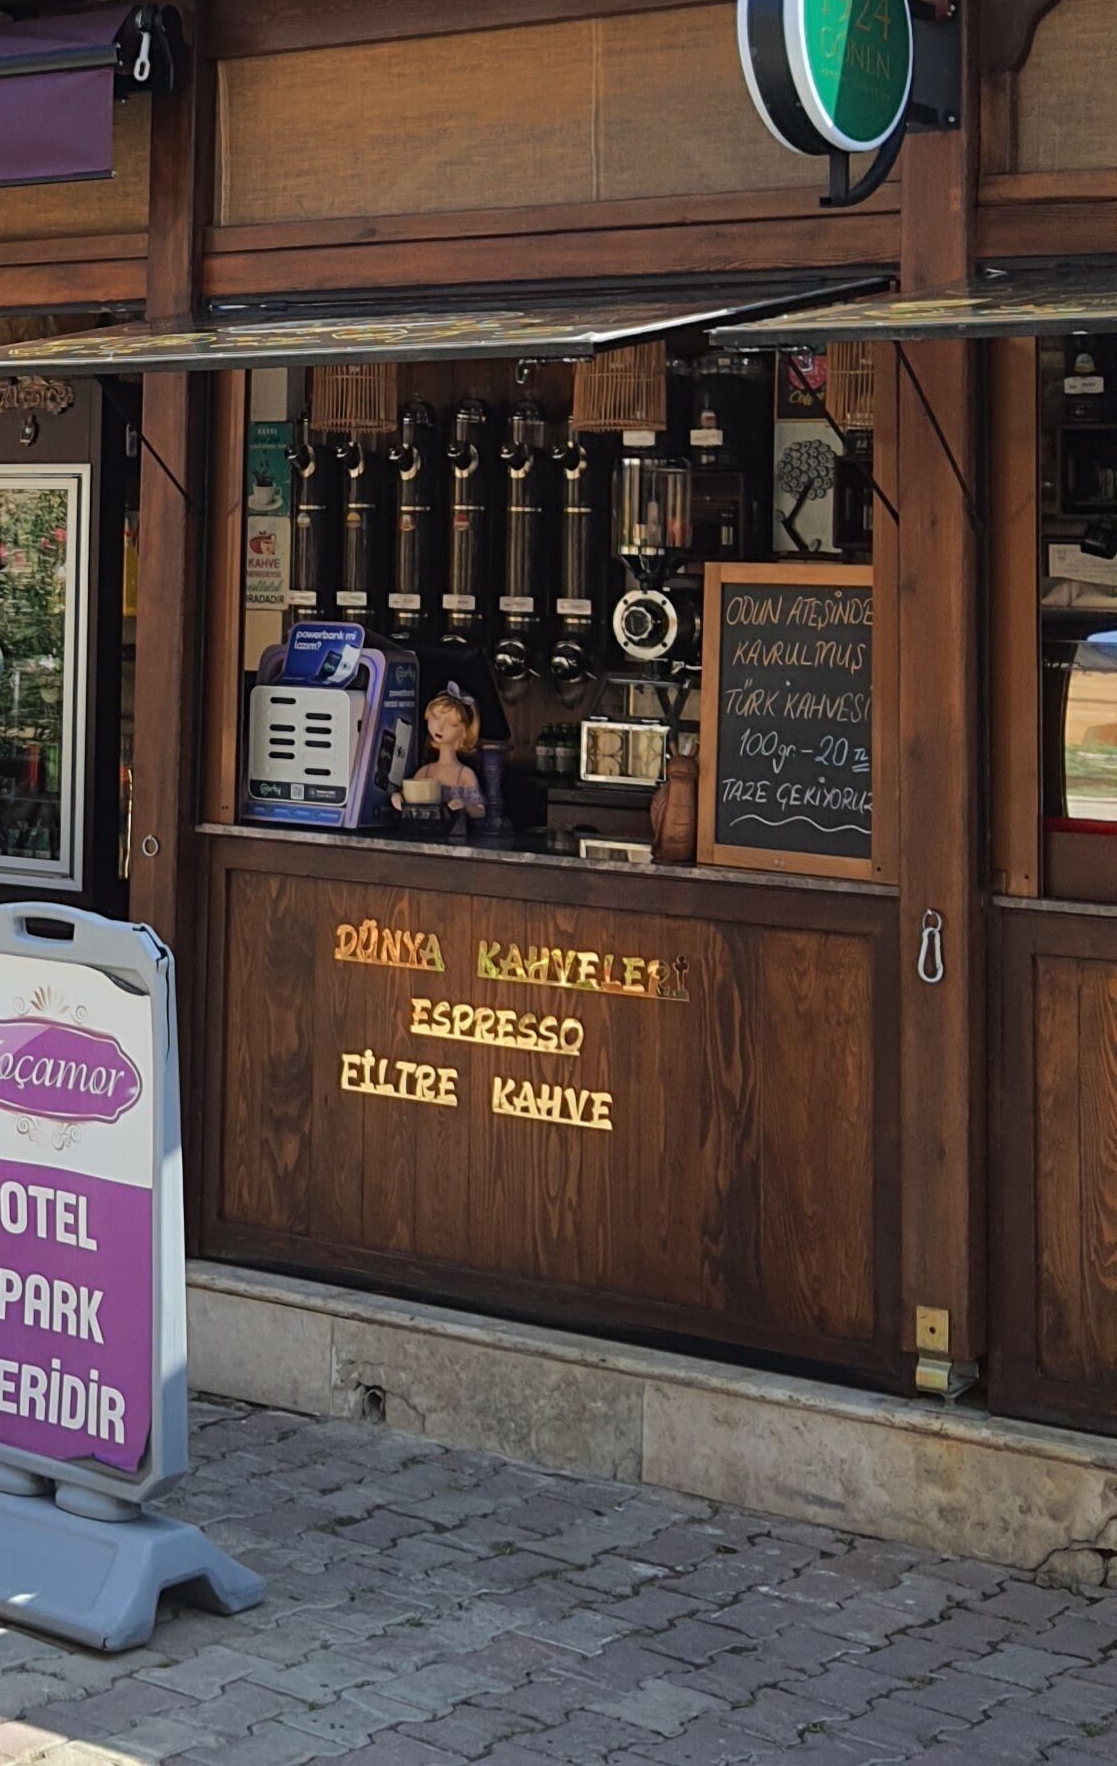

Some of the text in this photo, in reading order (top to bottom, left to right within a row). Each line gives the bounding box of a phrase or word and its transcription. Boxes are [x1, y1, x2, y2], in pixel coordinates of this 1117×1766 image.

[248, 558, 280, 568] KAHVE
[726, 590, 873, 631] ODUN ATEŞİNDE
[295, 629, 357, 641] powerbank mi
[733, 639, 866, 674] KAVRULMUŞ
[726, 679, 780, 718] TÜRK
[334, 919, 690, 1002] DÜNYA KAHVELERİ
[410, 998, 584, 1056] ESPRESSO
[341, 1049, 613, 1130] FİLTRE KAHVE
[0, 1180, 97, 1251] OTEL
